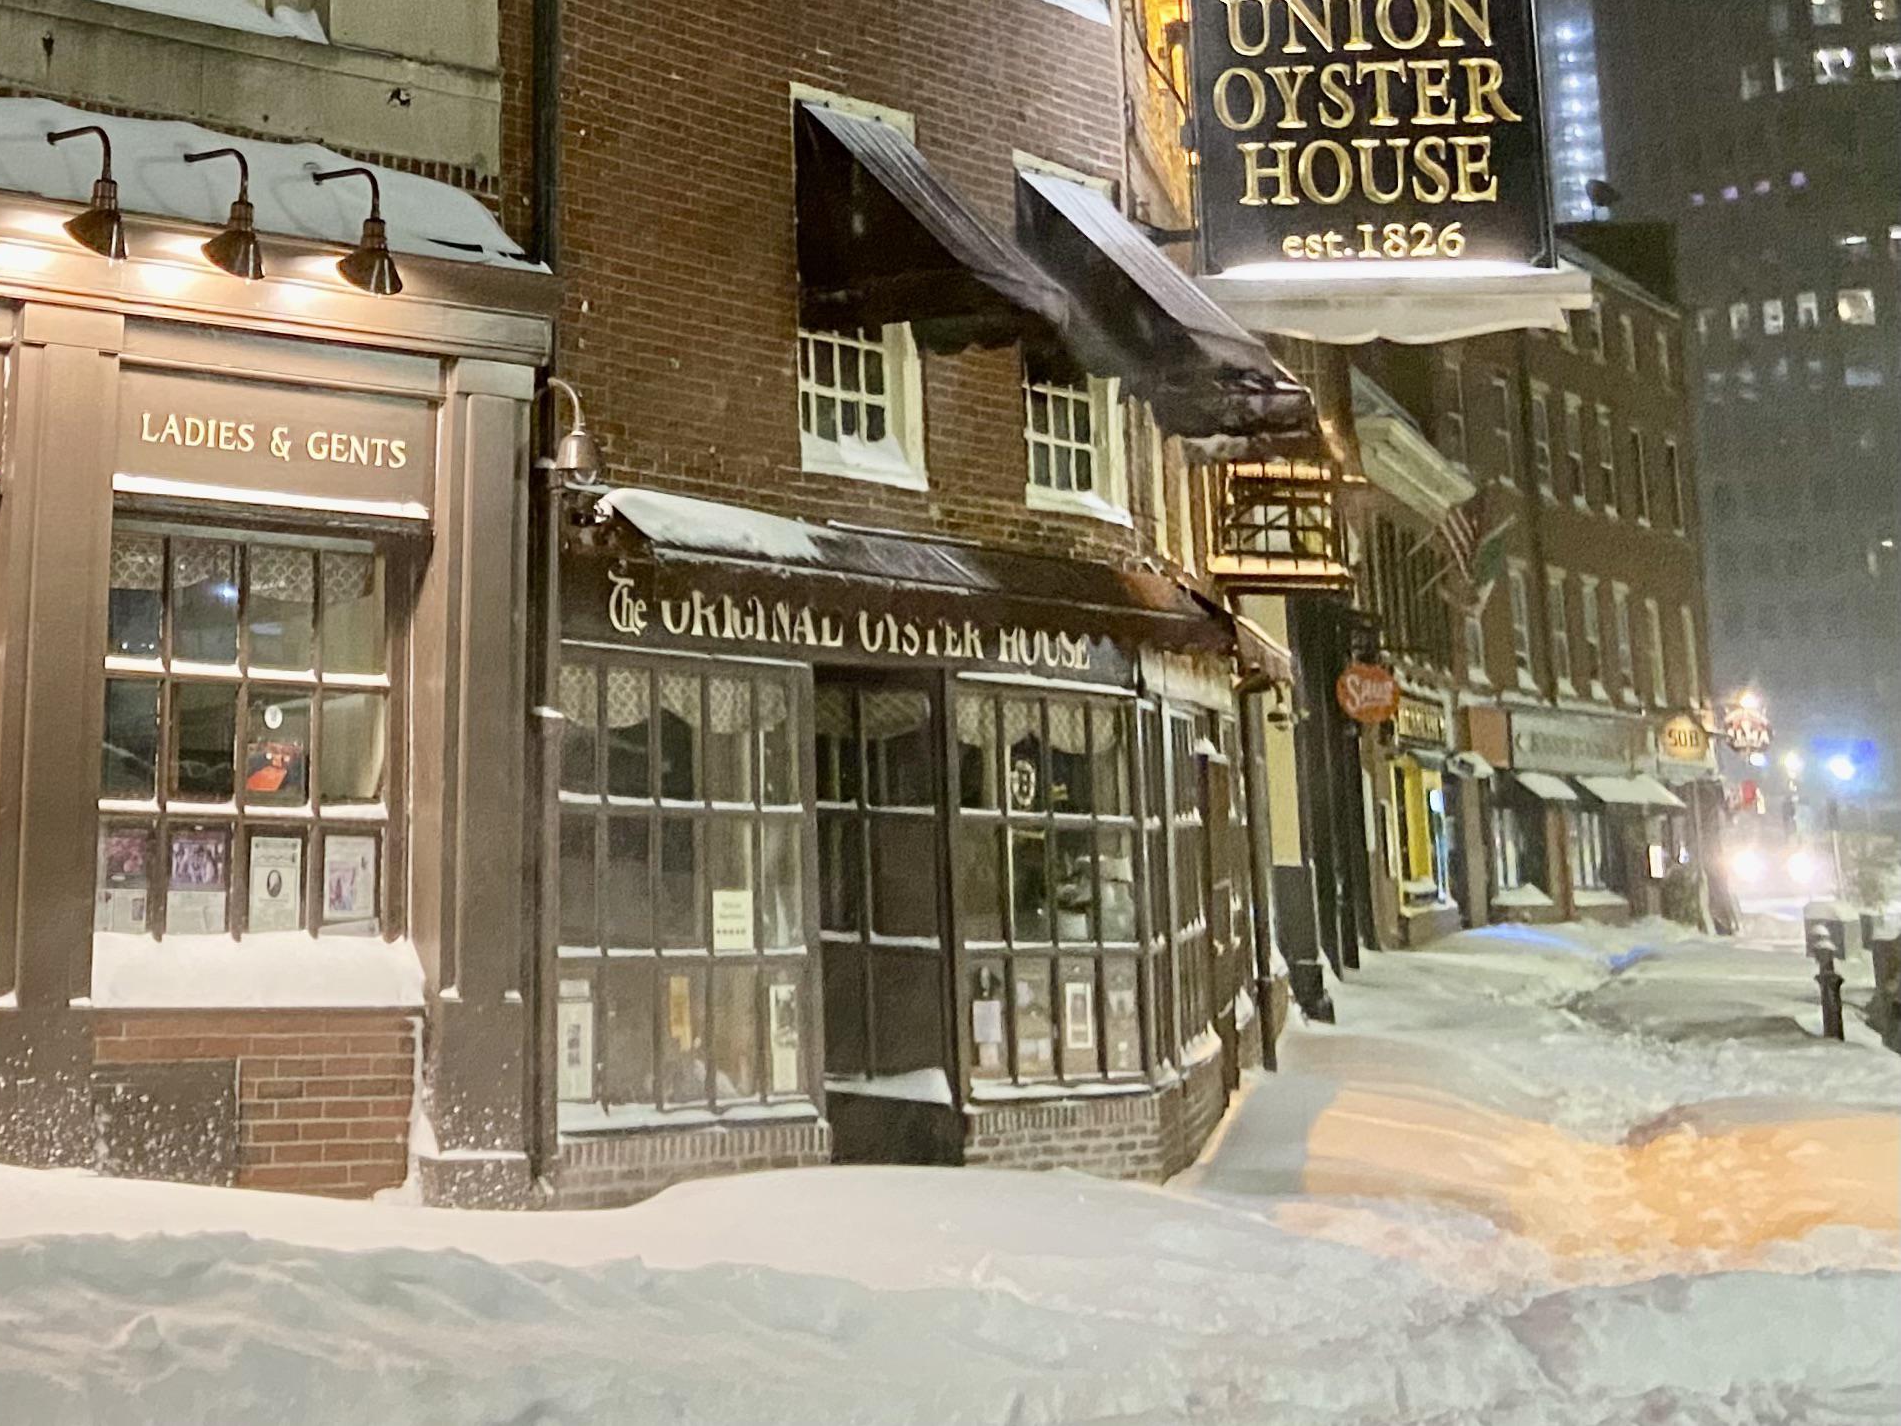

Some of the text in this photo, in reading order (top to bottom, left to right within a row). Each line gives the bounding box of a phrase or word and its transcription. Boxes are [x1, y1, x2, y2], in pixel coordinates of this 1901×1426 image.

[1213, 57, 1522, 132] OYSTER
[1238, 136, 1498, 206] HOUSE
[141, 412, 407, 469] LADIES & GENTS
[608, 570, 647, 636] The
